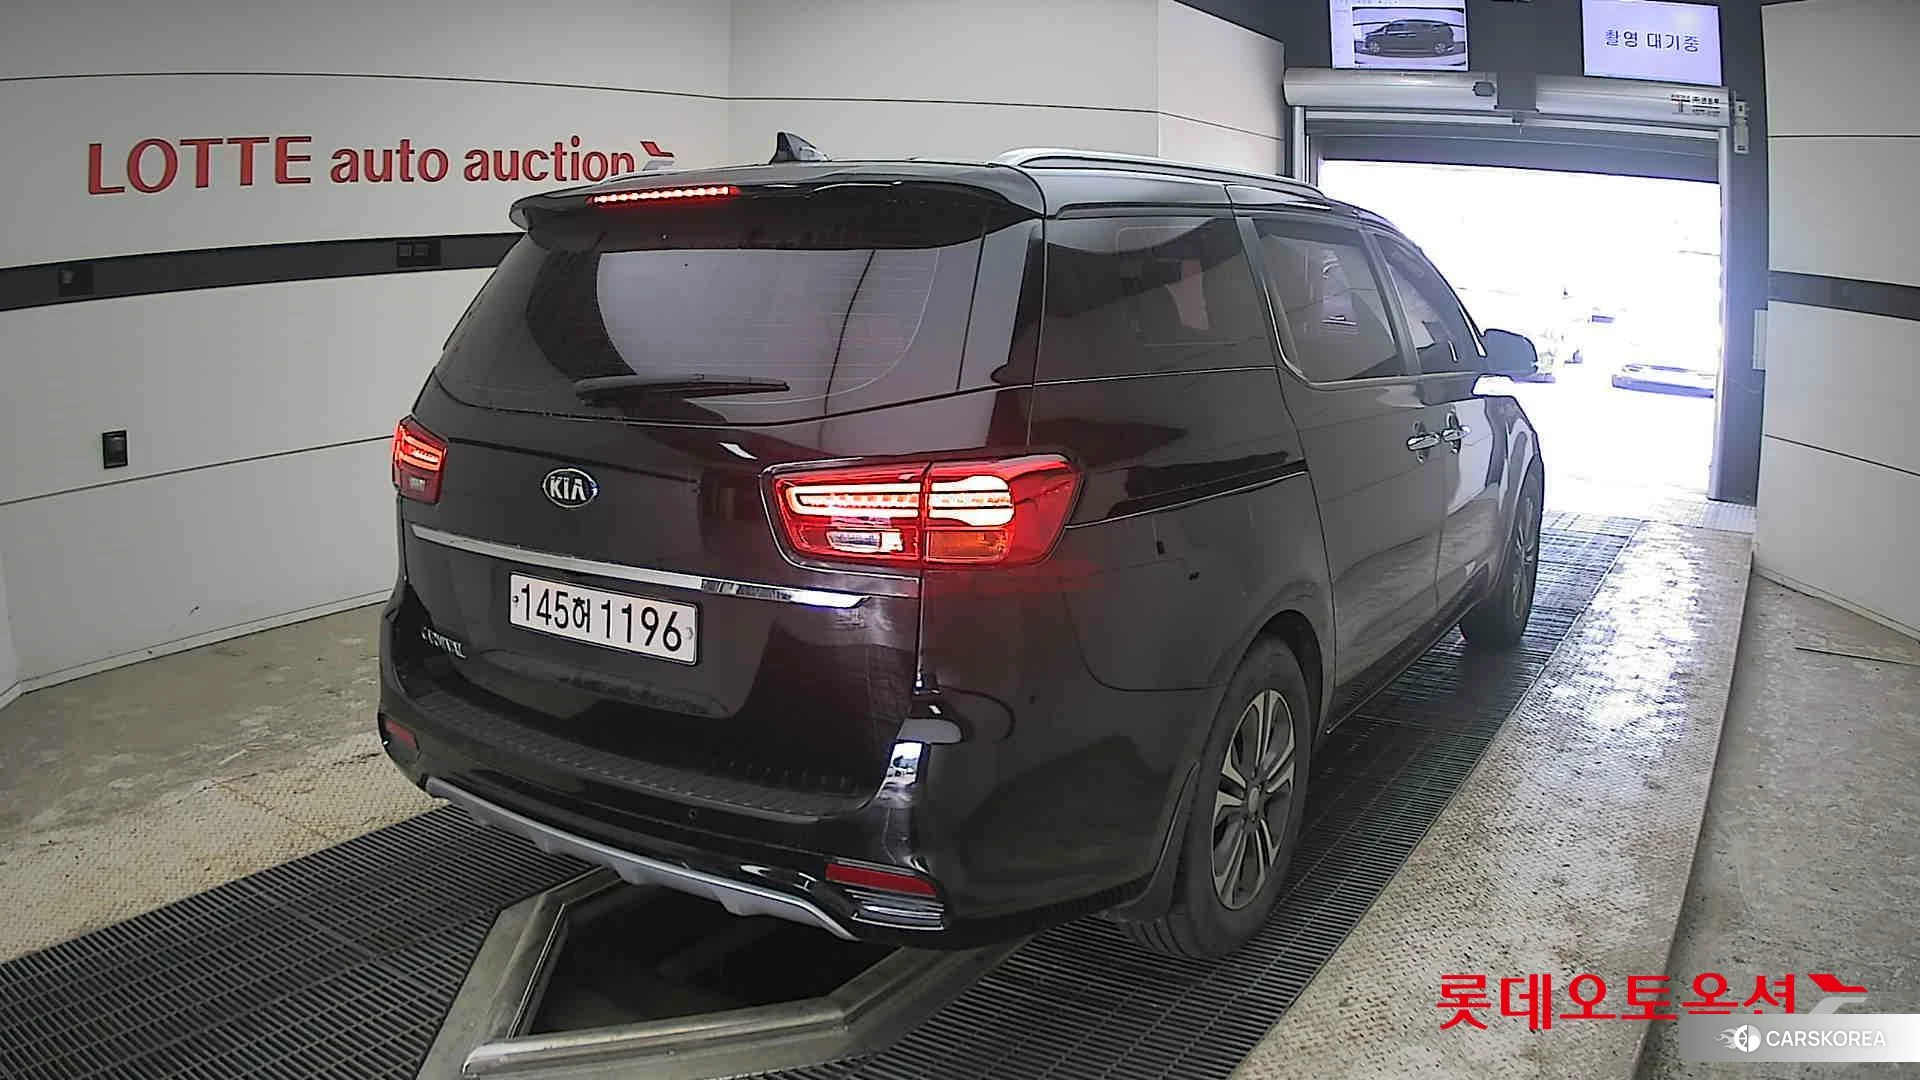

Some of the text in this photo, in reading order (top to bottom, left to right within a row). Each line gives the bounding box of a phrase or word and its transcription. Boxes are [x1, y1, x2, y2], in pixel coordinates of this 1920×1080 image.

[1647, 33, 1699, 52] 대기중
[87, 135, 635, 195] LOTTE auto auction
[550, 476, 587, 501] KIA
